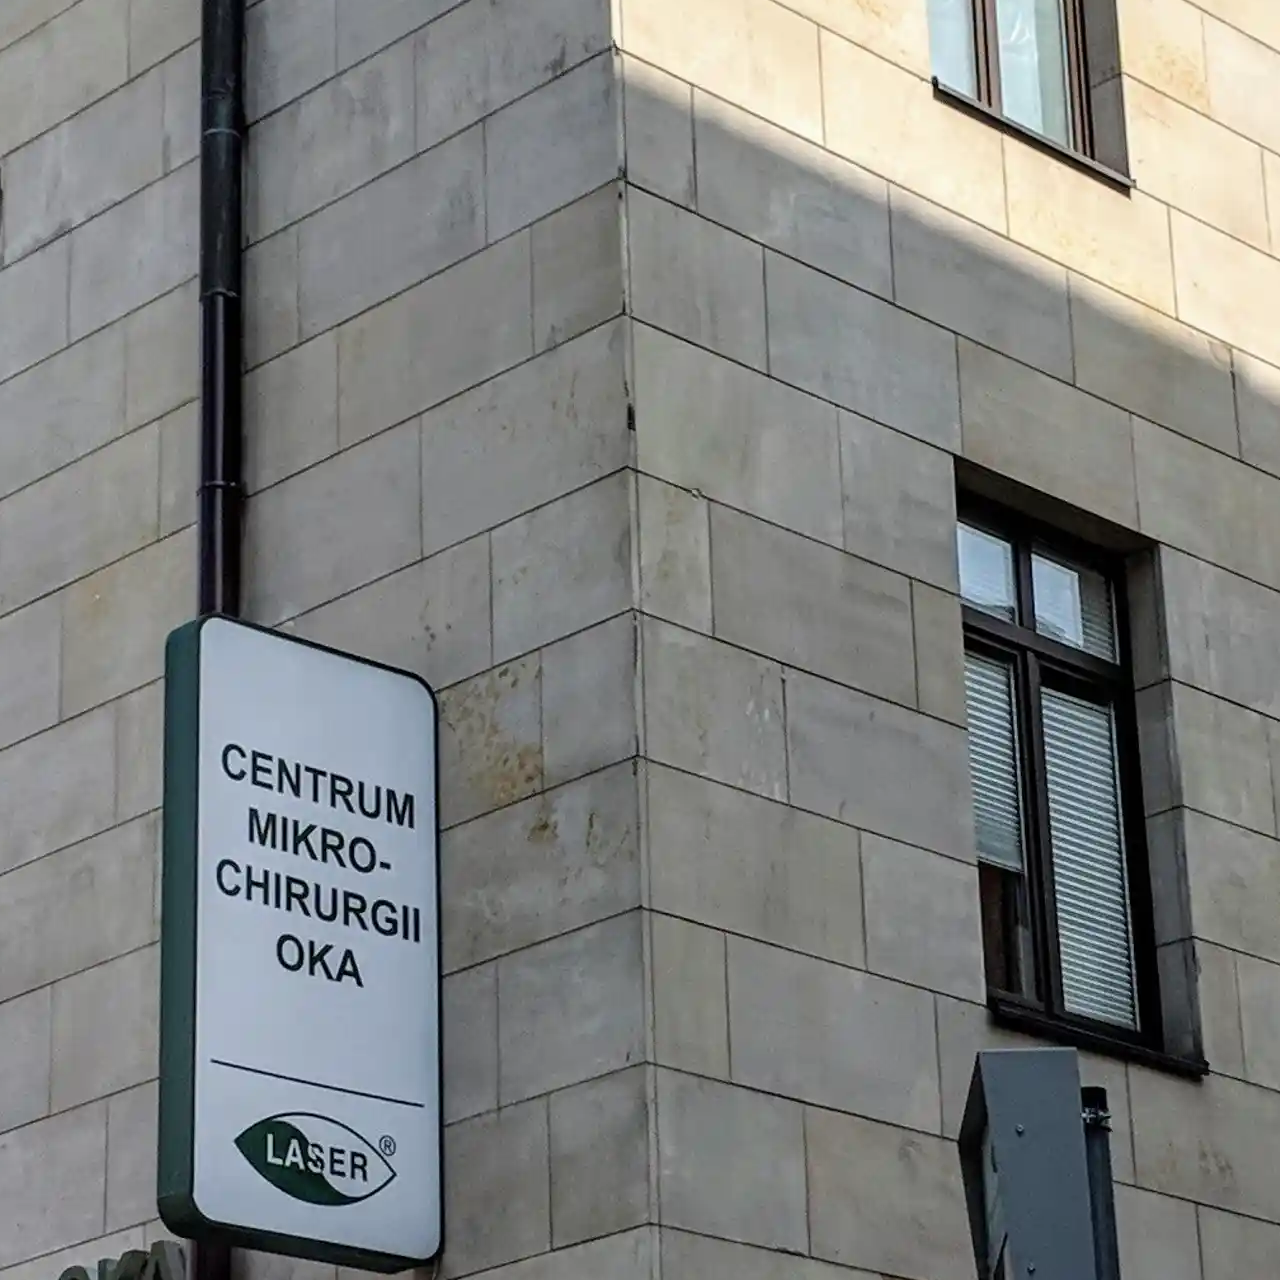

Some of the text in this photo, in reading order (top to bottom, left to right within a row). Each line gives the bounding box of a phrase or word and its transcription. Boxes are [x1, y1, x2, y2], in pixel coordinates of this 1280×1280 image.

[221, 743, 416, 830] CENTRUM
[247, 806, 393, 875] MIKRO-
[215, 859, 422, 945] CHIRURGII
[275, 933, 365, 989] OKA
[265, 1131, 370, 1183] LASER
